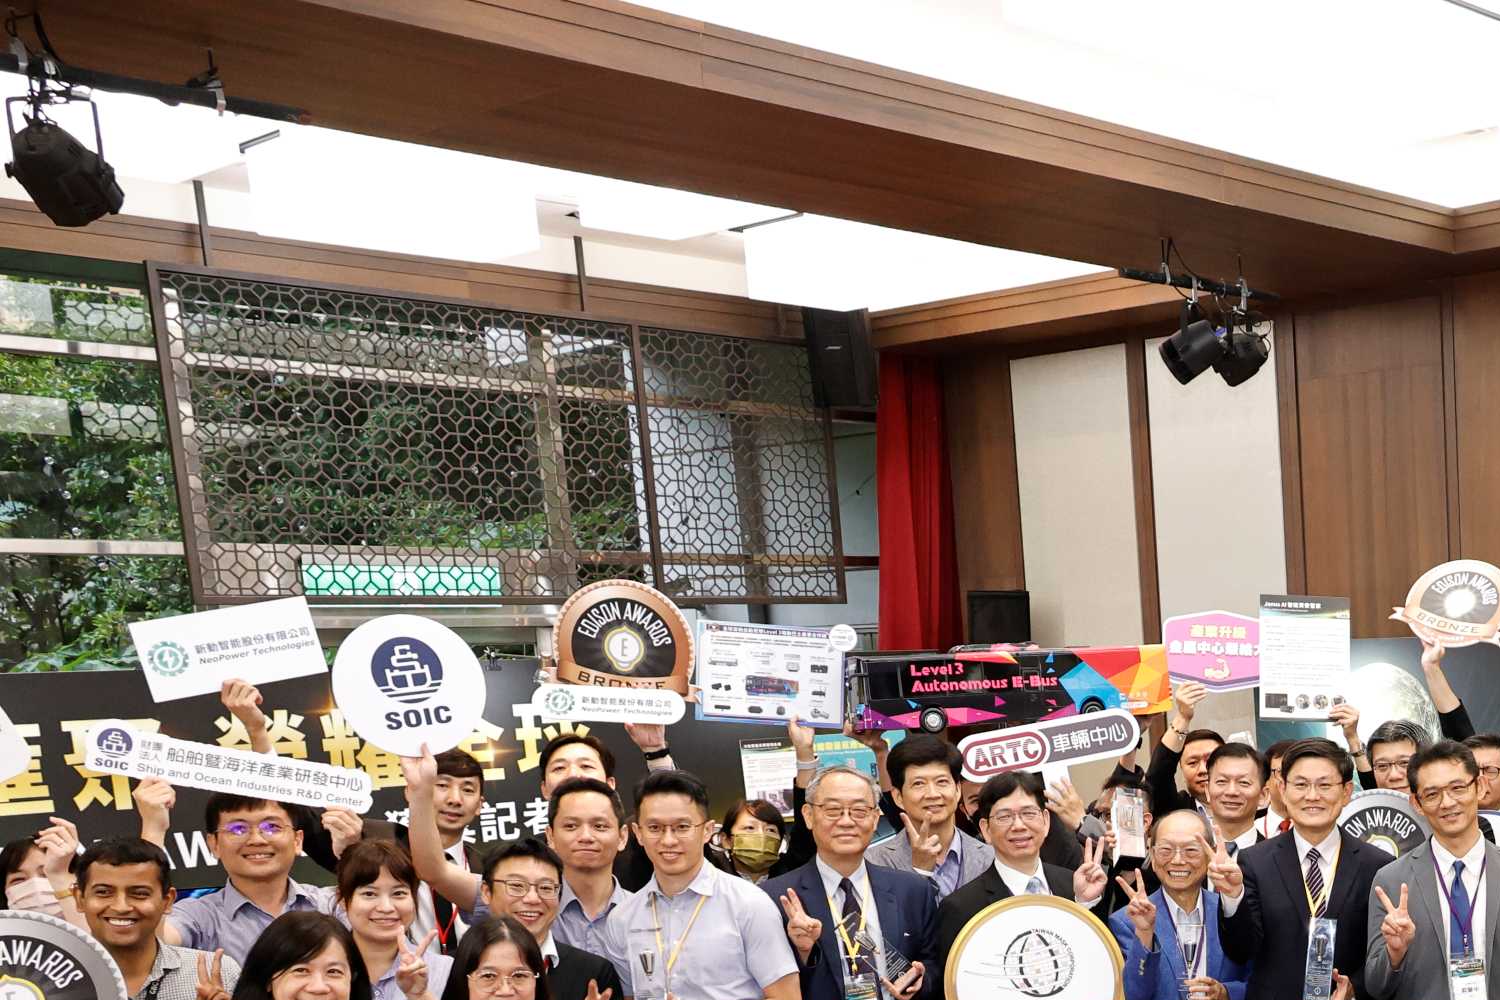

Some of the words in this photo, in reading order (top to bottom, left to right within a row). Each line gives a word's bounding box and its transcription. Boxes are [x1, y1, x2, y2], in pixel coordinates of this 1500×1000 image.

[1432, 572, 1470, 594] EDISON
[1469, 574, 1498, 605] AWARDS
[577, 601, 622, 638] EDISON
[623, 602, 672, 647] AWARDS
[1416, 612, 1481, 634] BRONZE
[199, 652, 250, 665] NeoPower
[252, 639, 315, 657] Technologies
[911, 664, 952, 676] Level
[912, 678, 1008, 693] Autonomous
[1011, 675, 1058, 688] E-Bus
[384, 705, 452, 730] SOIC
[974, 737, 1038, 770] ARTC
[1053, 722, 1128, 753] 車輛中心
[94, 757, 129, 772] SOIC
[166, 746, 364, 793] 船舶暨海洋產業研發中心
[137, 762, 166, 779] Ship
[167, 766, 190, 780] and
[194, 770, 234, 787] Ocean
[236, 776, 294, 797] Industries
[296, 785, 322, 800] R&D
[326, 791, 364, 807] Center
[1366, 809, 1417, 839] AWARDS
